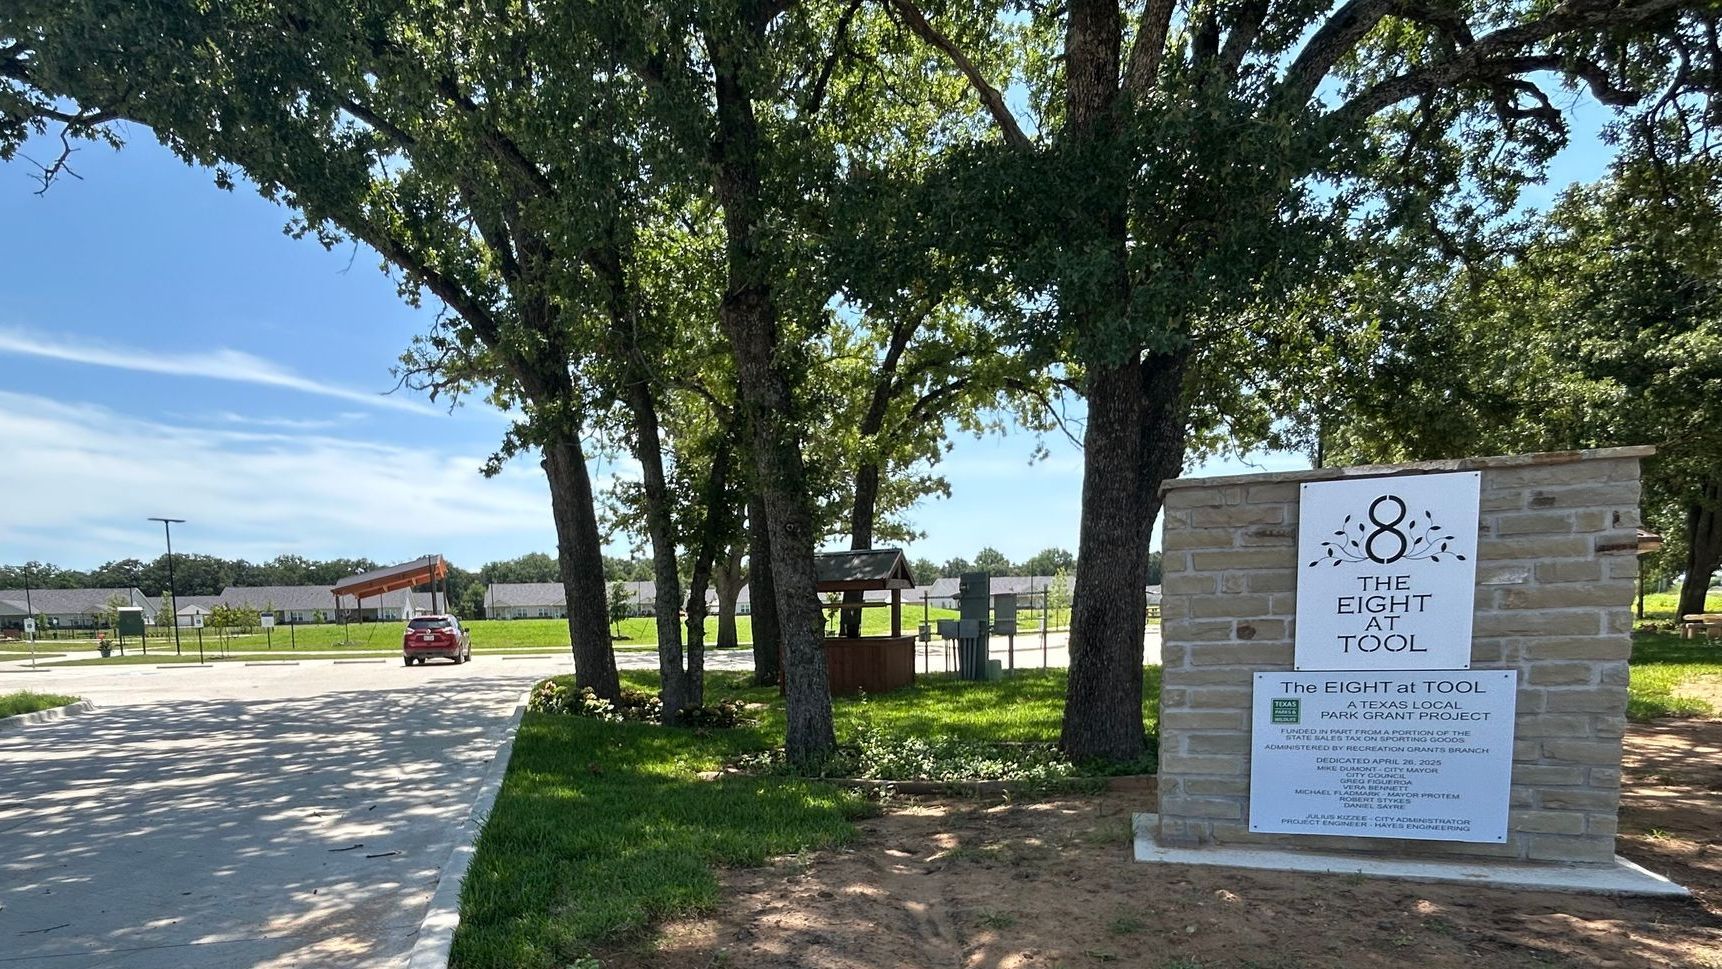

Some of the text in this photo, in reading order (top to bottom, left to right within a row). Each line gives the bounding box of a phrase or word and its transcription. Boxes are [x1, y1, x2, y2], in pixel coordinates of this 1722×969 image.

[1366, 495, 1407, 564] 8
[1357, 575, 1410, 591] THE
[1337, 594, 1432, 614] EIGHT
[1365, 616, 1400, 631] AT
[1338, 634, 1427, 652] TOOL
[1281, 681, 1486, 693] The EIGHT at TOOL
[1360, 701, 1408, 709] TEXAS
[1413, 701, 1463, 709] LOCAL
[1321, 712, 1491, 720] PARK GRANT PROJECT
